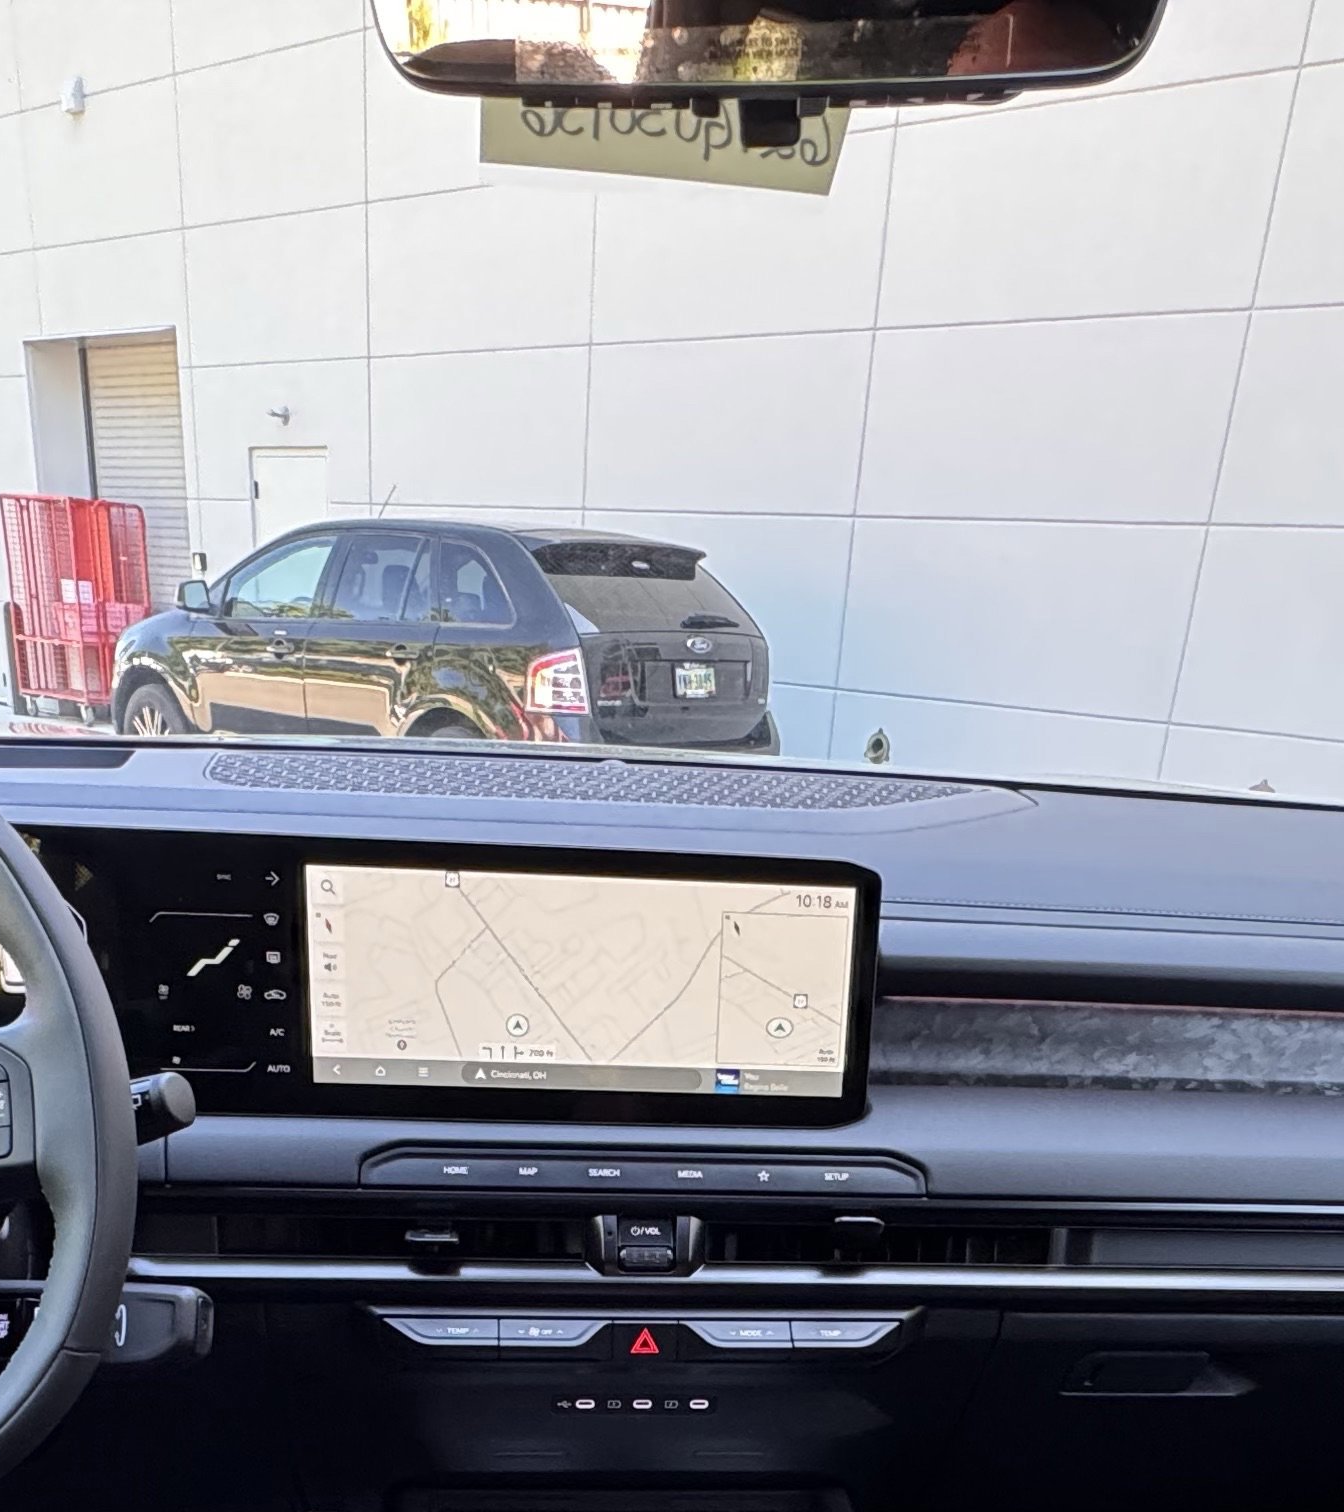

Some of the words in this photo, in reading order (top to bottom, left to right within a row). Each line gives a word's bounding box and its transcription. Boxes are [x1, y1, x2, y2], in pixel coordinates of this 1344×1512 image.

[796, 894, 832, 909] 10:18
[269, 1028, 285, 1036] A/C
[267, 1062, 291, 1074] AUTO
[443, 1166, 469, 1175] HOME
[518, 1166, 538, 1175] MAP
[588, 1168, 620, 1177] SEARCH
[677, 1170, 703, 1179] MEDIA
[824, 1172, 849, 1181] SETUP
[447, 1326, 470, 1335] TEMP
[739, 1329, 763, 1337] MODE
[819, 1329, 842, 1337] TEMP
